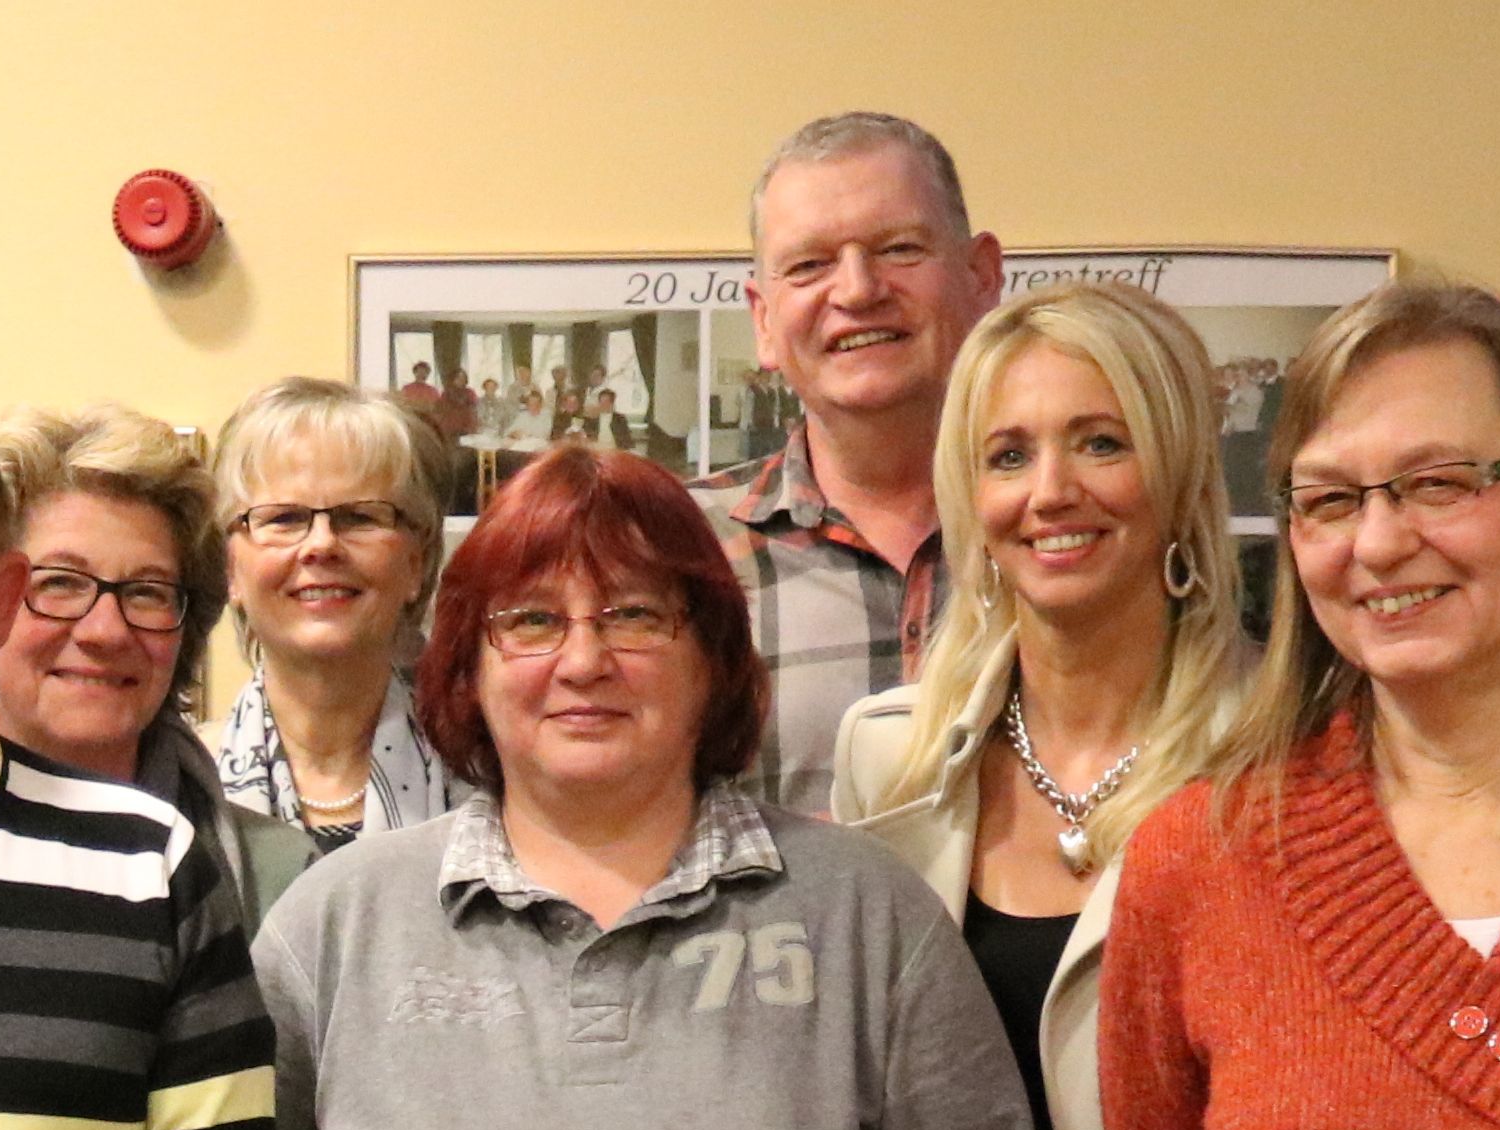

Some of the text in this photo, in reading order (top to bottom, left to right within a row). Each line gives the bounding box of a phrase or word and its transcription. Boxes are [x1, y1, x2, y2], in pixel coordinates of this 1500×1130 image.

[624, 258, 1173, 304] 20 Ja rentreff
[670, 921, 816, 1014] 75
